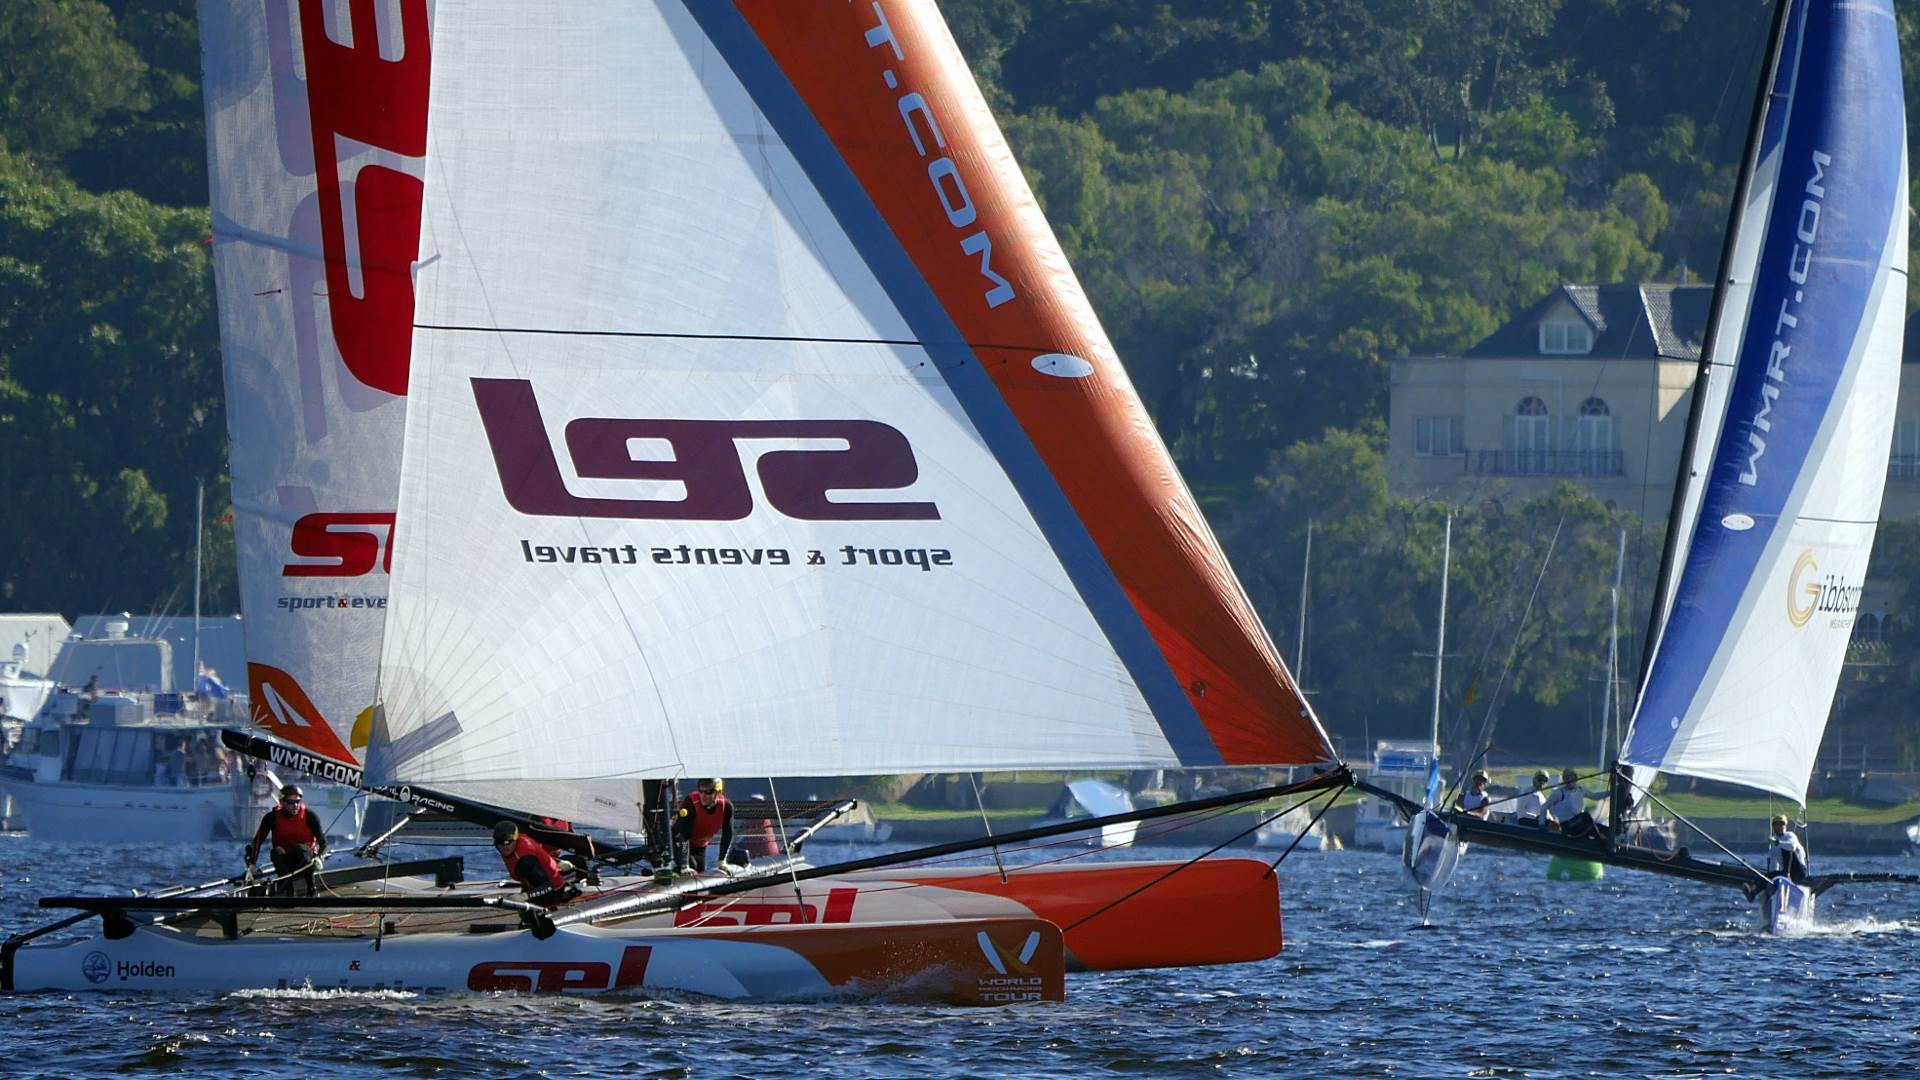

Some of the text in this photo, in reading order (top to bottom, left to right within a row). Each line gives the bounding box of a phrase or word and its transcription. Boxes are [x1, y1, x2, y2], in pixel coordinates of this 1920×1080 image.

[847, 0, 1016, 308] T.COM
[1739, 150, 1831, 486] WMRT.COM
[277, 596, 335, 612] sport
[270, 745, 361, 788] WMRT.COM
[411, 793, 455, 813] RACING
[117, 960, 175, 980] Holden
[349, 960, 361, 971] &
[979, 993, 1041, 1001] TOUR
